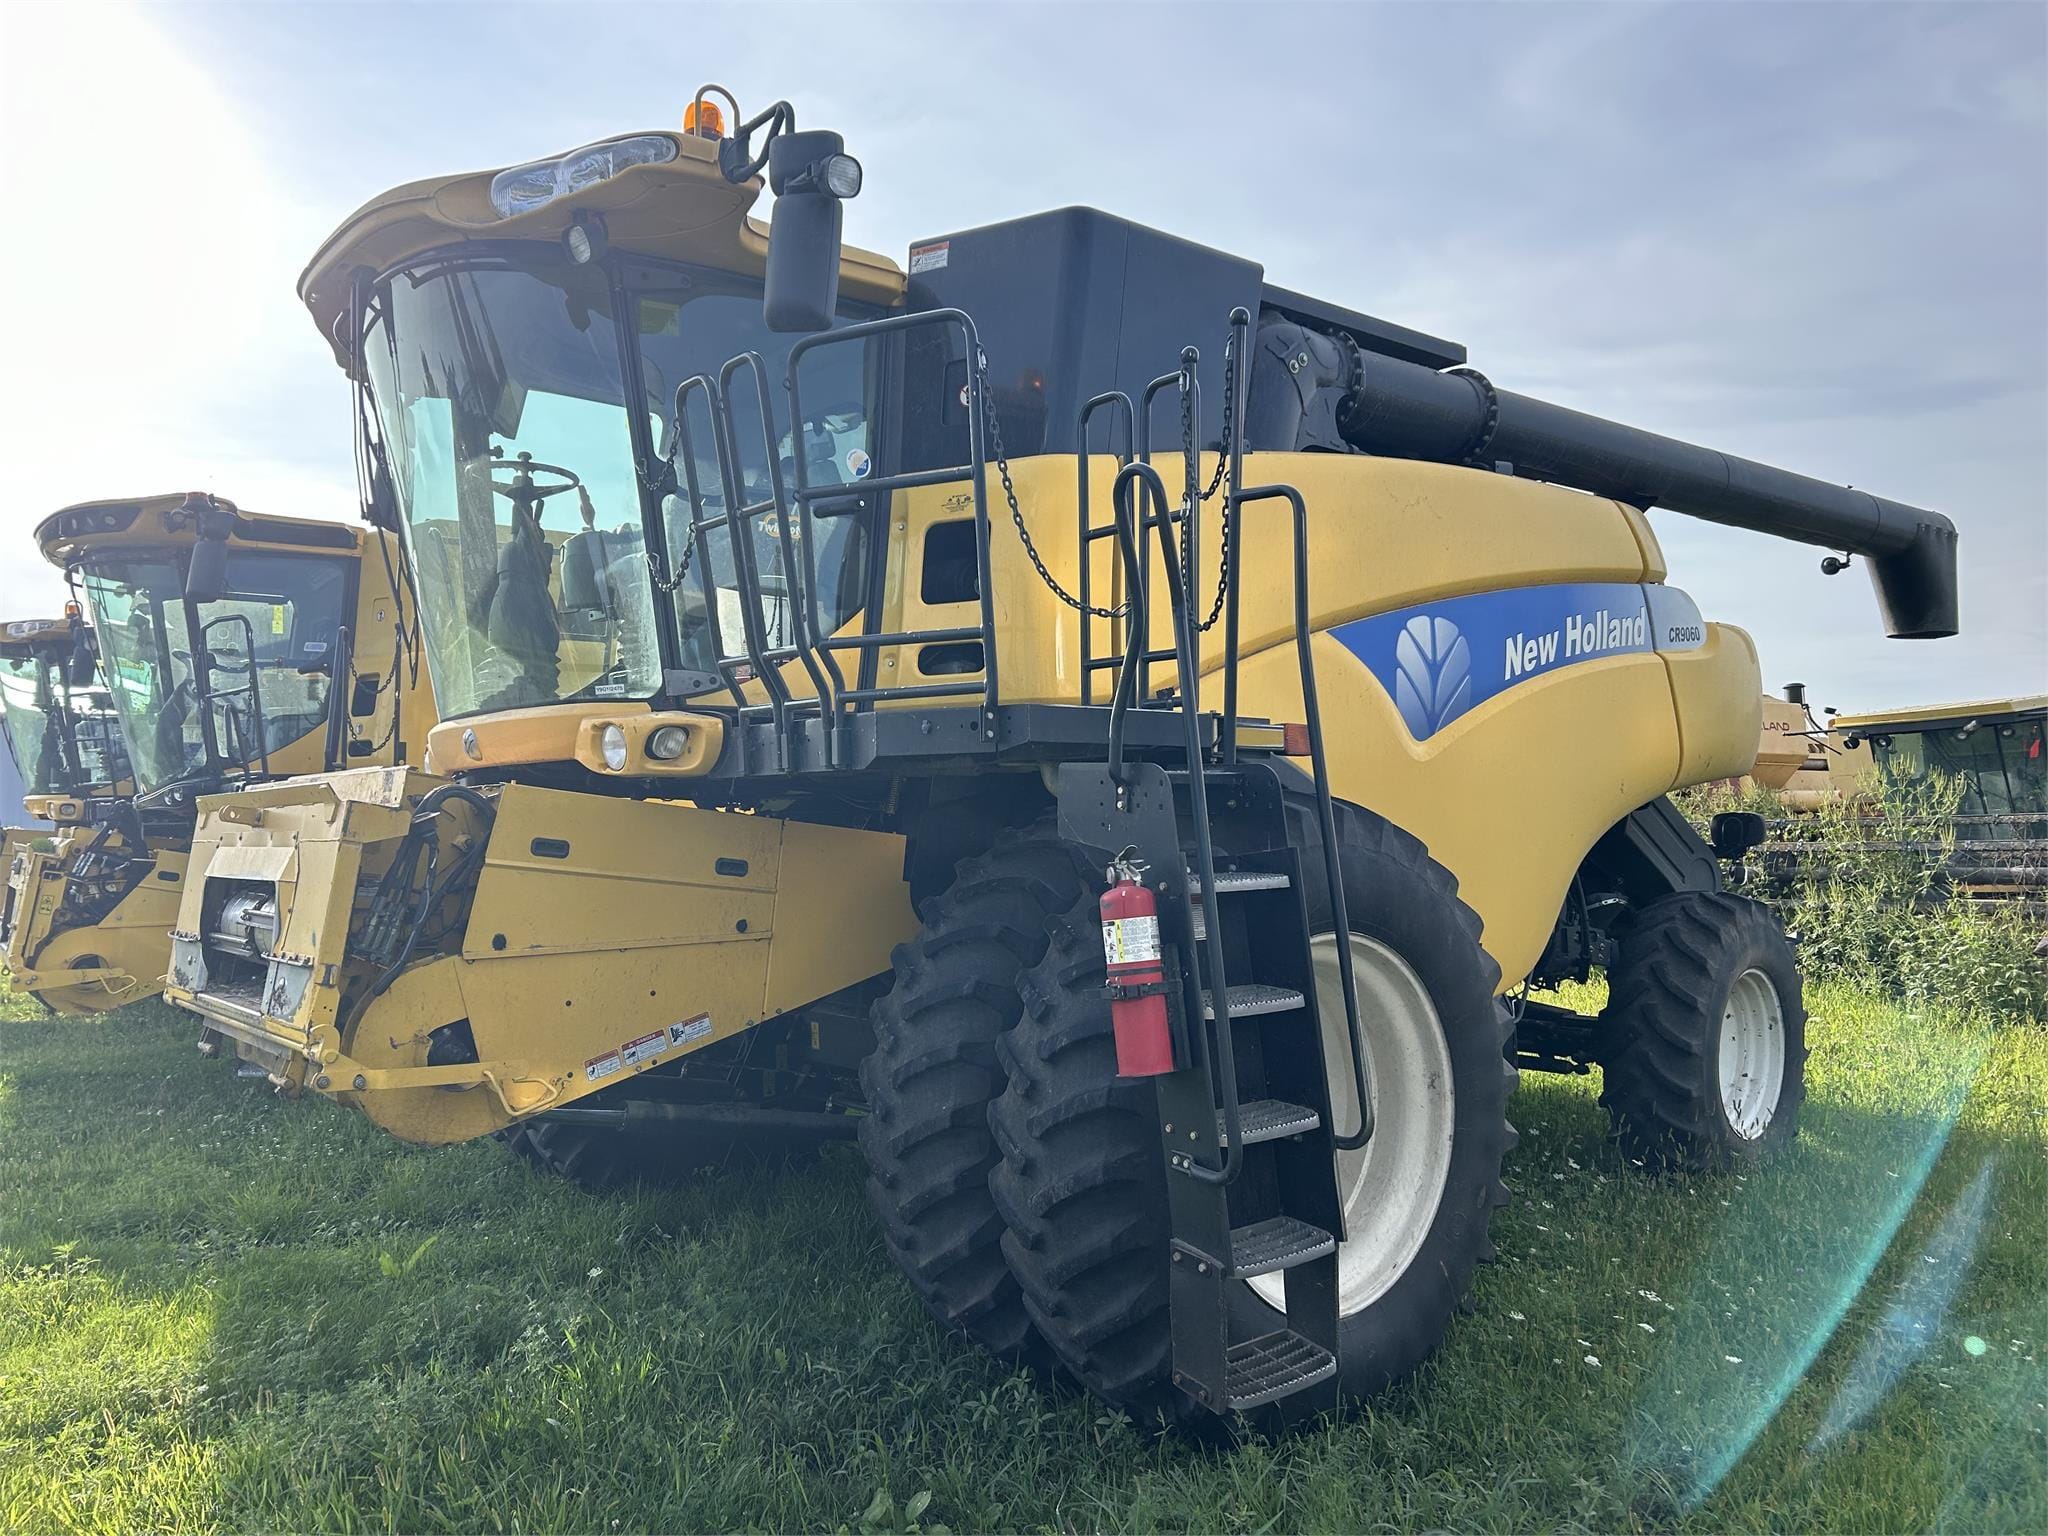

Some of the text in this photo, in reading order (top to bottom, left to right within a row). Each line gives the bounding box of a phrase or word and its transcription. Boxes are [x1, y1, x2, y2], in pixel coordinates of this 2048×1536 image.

[1504, 606, 1645, 680] New Holland
[1668, 626, 1701, 643] CR9060
[1760, 721, 1790, 731] LAND
